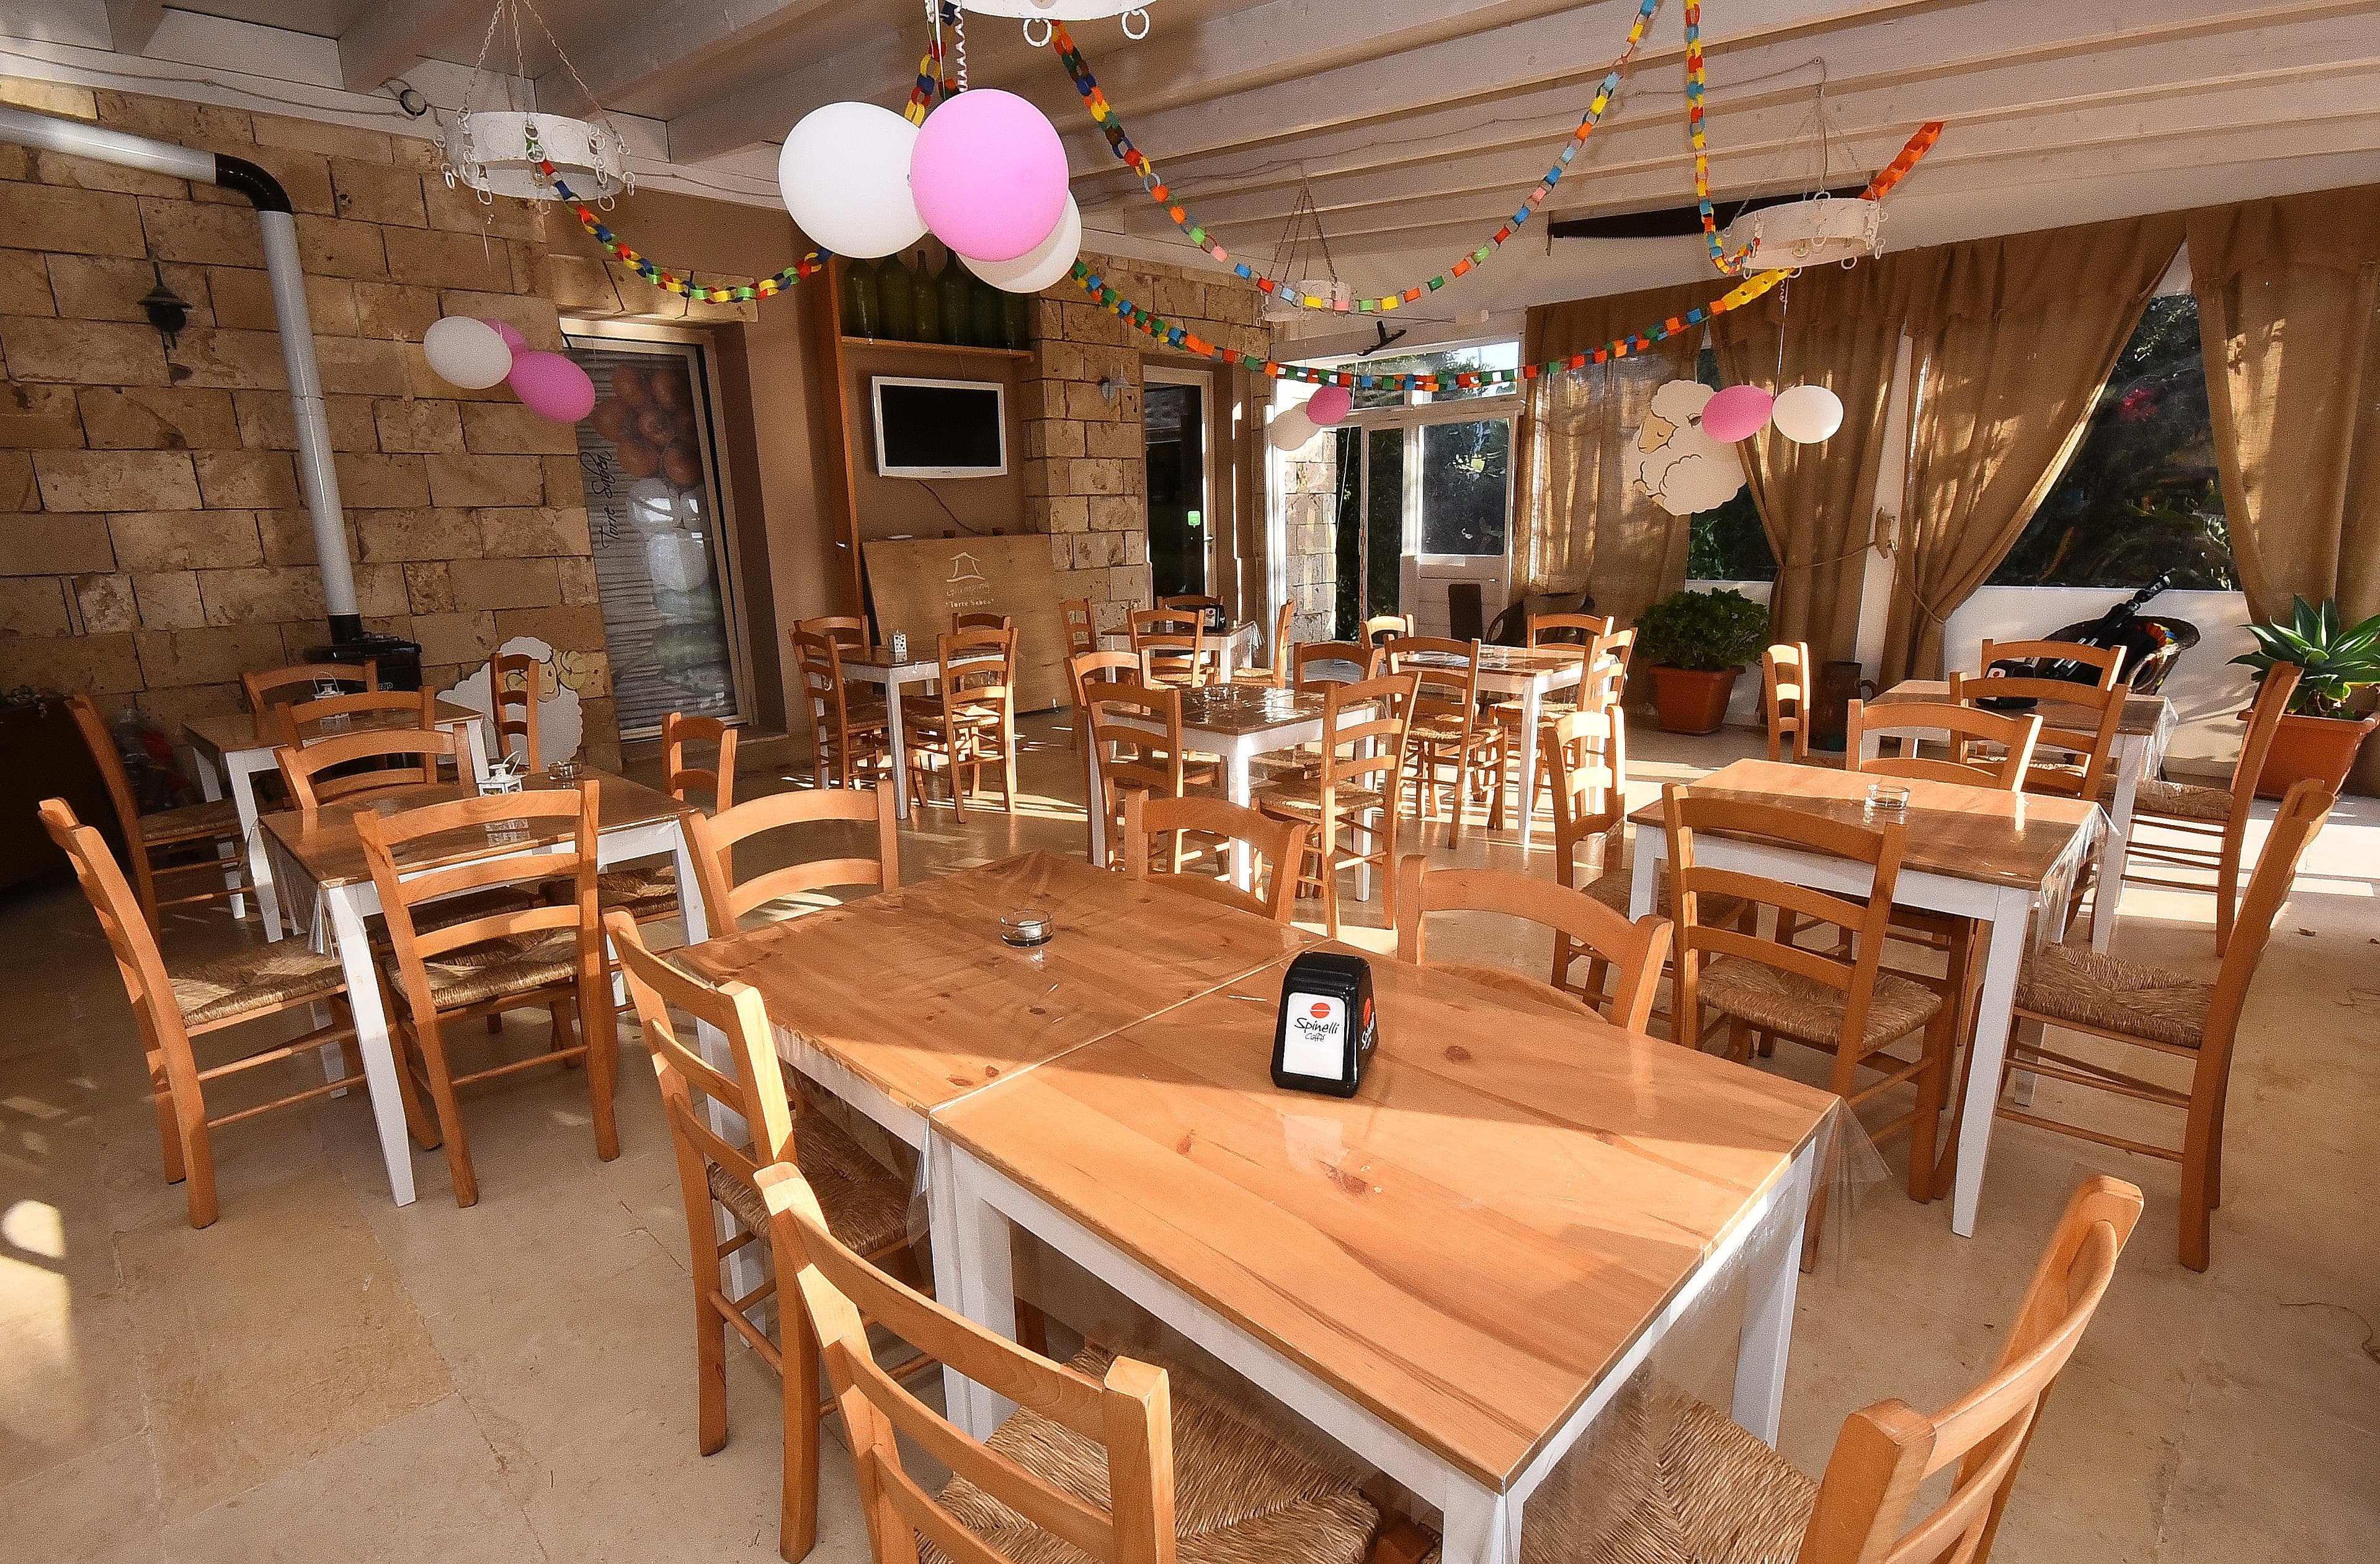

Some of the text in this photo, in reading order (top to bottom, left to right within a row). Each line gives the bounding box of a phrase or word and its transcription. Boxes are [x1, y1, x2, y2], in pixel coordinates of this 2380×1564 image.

[579, 450, 620, 549] Torre Sabea
[1294, 1017, 1340, 1034] Spinelli
